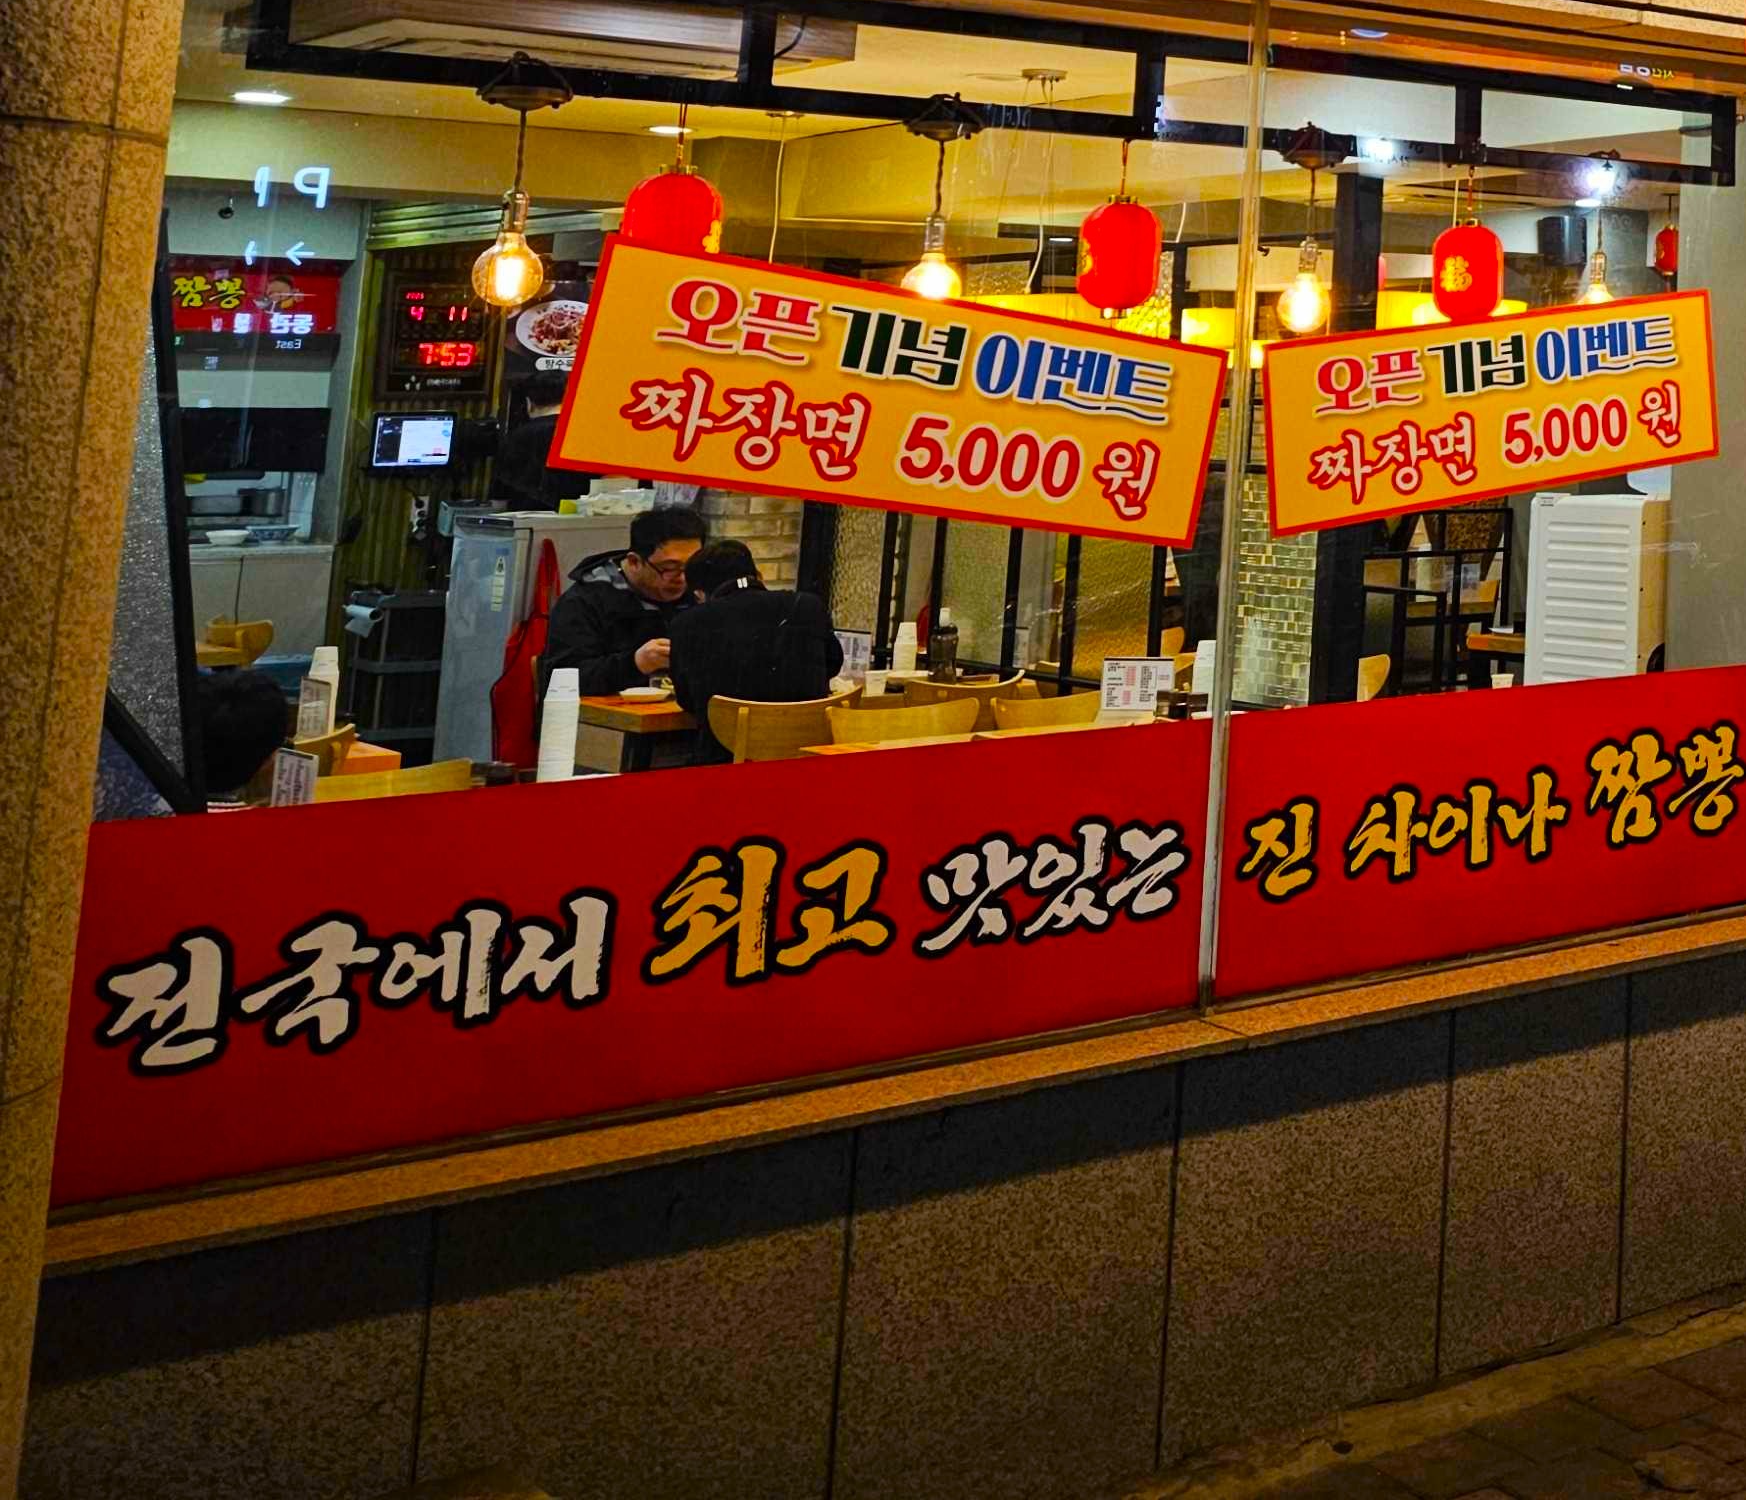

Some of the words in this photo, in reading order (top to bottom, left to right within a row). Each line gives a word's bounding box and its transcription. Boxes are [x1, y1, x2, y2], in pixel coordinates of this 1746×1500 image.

[172, 275, 246, 309] 짬뽕
[419, 343, 473, 366] 7:53
[657, 279, 820, 365] 오픈
[831, 303, 969, 388] 기념
[973, 332, 1173, 425] 이벤트
[1313, 348, 1425, 416] 오픈
[1426, 333, 1526, 398] 기념
[1535, 315, 1677, 382] 이벤트
[621, 368, 870, 482] 짜장면
[898, 415, 1083, 501] 5,000
[1095, 439, 1160, 522] 원
[1310, 411, 1475, 505] 짜장면
[1503, 397, 1629, 465] 5,000
[1639, 380, 1681, 447] 원
[1240, 796, 1319, 899] 진
[1346, 765, 1568, 879] 차이나
[1588, 722, 1746, 846] 짬뽕
[102, 891, 618, 1074] 전국에서
[645, 839, 894, 983] 최고
[917, 816, 1192, 952] 맛있는
